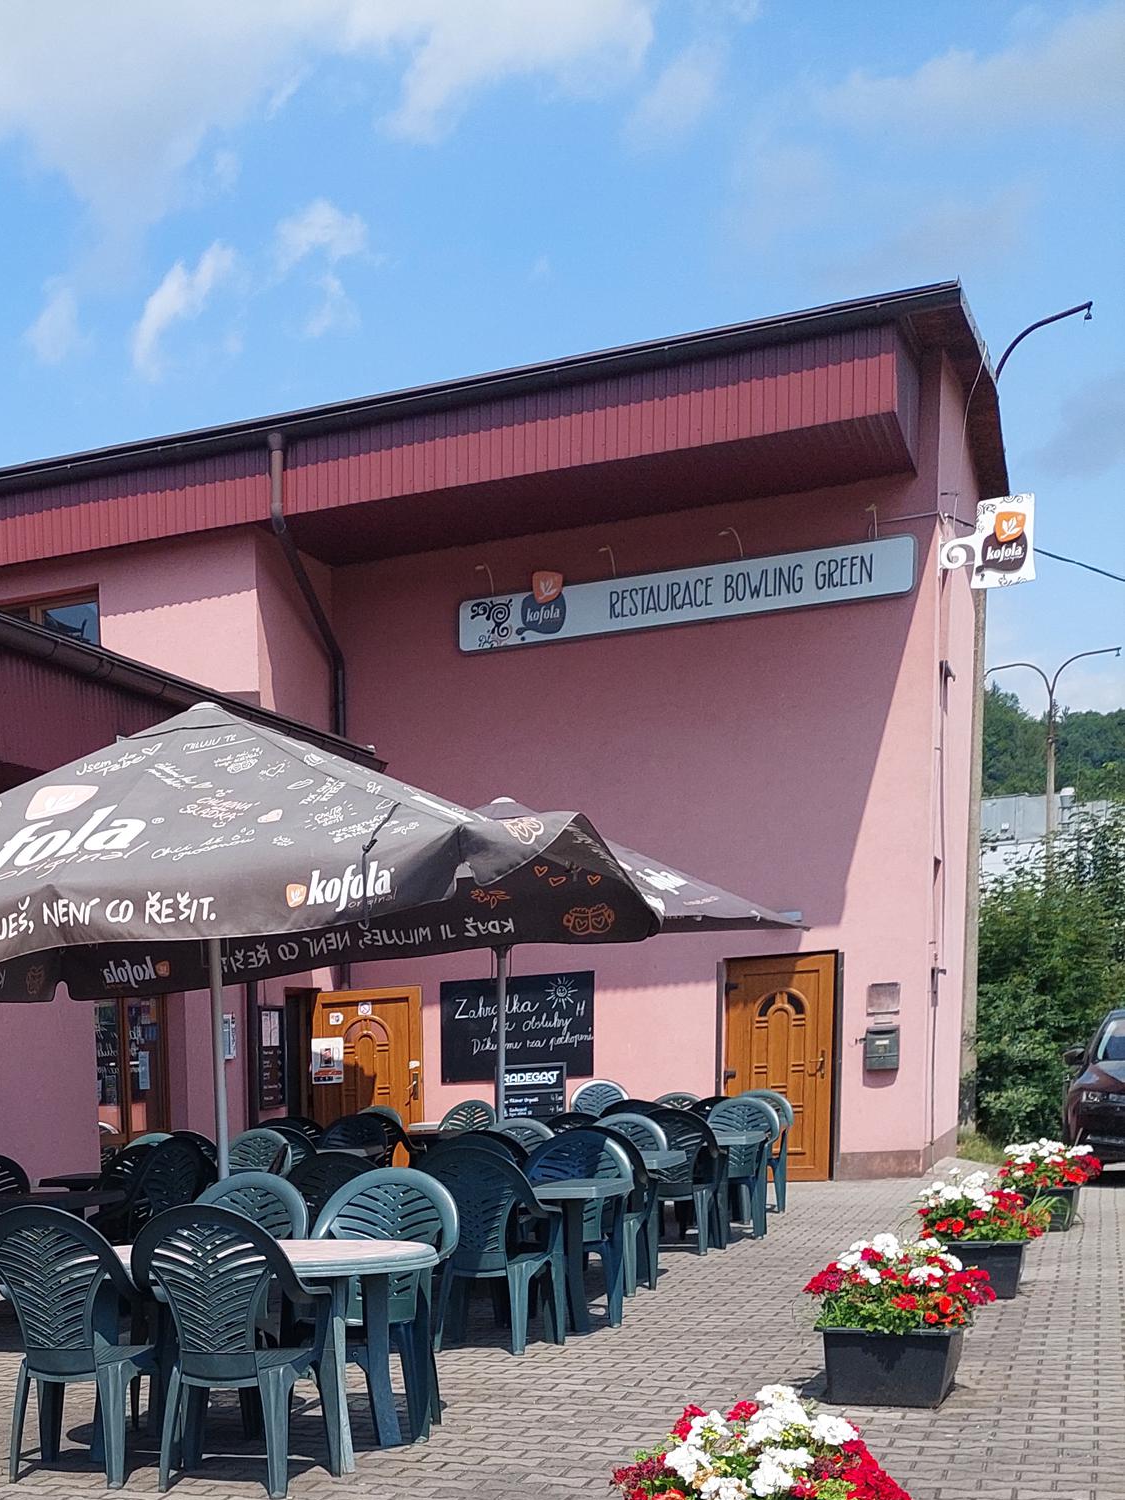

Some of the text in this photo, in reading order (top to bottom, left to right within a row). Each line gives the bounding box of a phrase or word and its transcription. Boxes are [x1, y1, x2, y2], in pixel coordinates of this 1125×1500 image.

[986, 542, 1023, 562] kofola
[609, 553, 874, 619] RESTAURACE BOWLING GREEN
[526, 604, 560, 625] kofola
[306, 860, 392, 913] kofola
[347, 886, 398, 910] orginal
[42, 897, 101, 927] NENÍ
[105, 899, 134, 923] CO
[144, 891, 217, 924] ŘEŠIT.
[504, 1070, 561, 1084] RADEGAST
